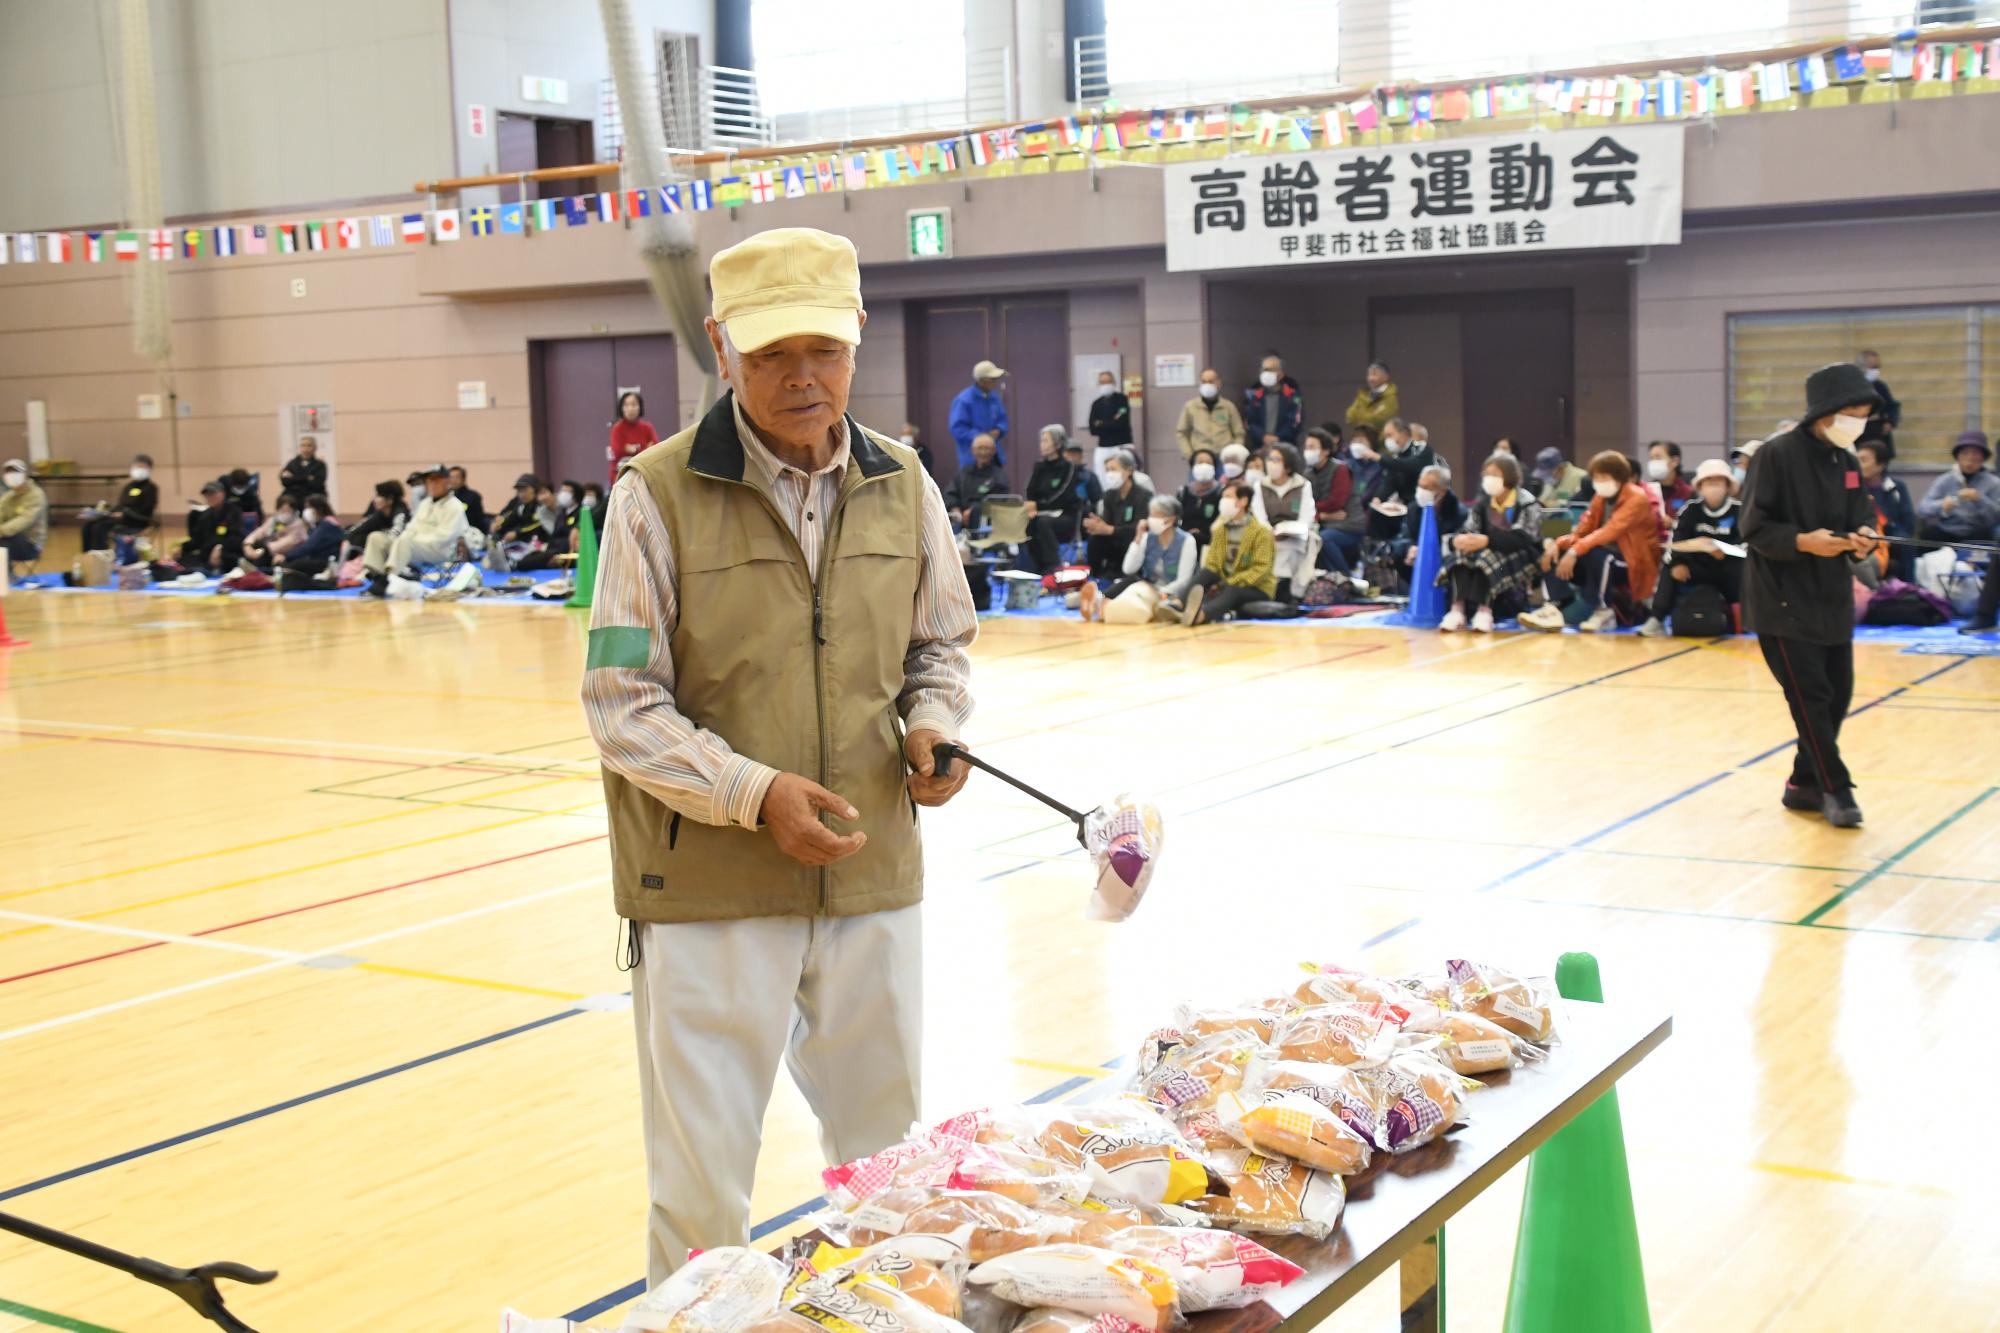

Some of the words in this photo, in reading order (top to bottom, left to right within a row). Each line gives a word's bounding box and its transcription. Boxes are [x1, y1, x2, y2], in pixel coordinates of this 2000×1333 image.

[1190, 136, 1639, 235] 高齢者運動会
[1280, 219, 1546, 257] 甲斐市社会福祉協議会
